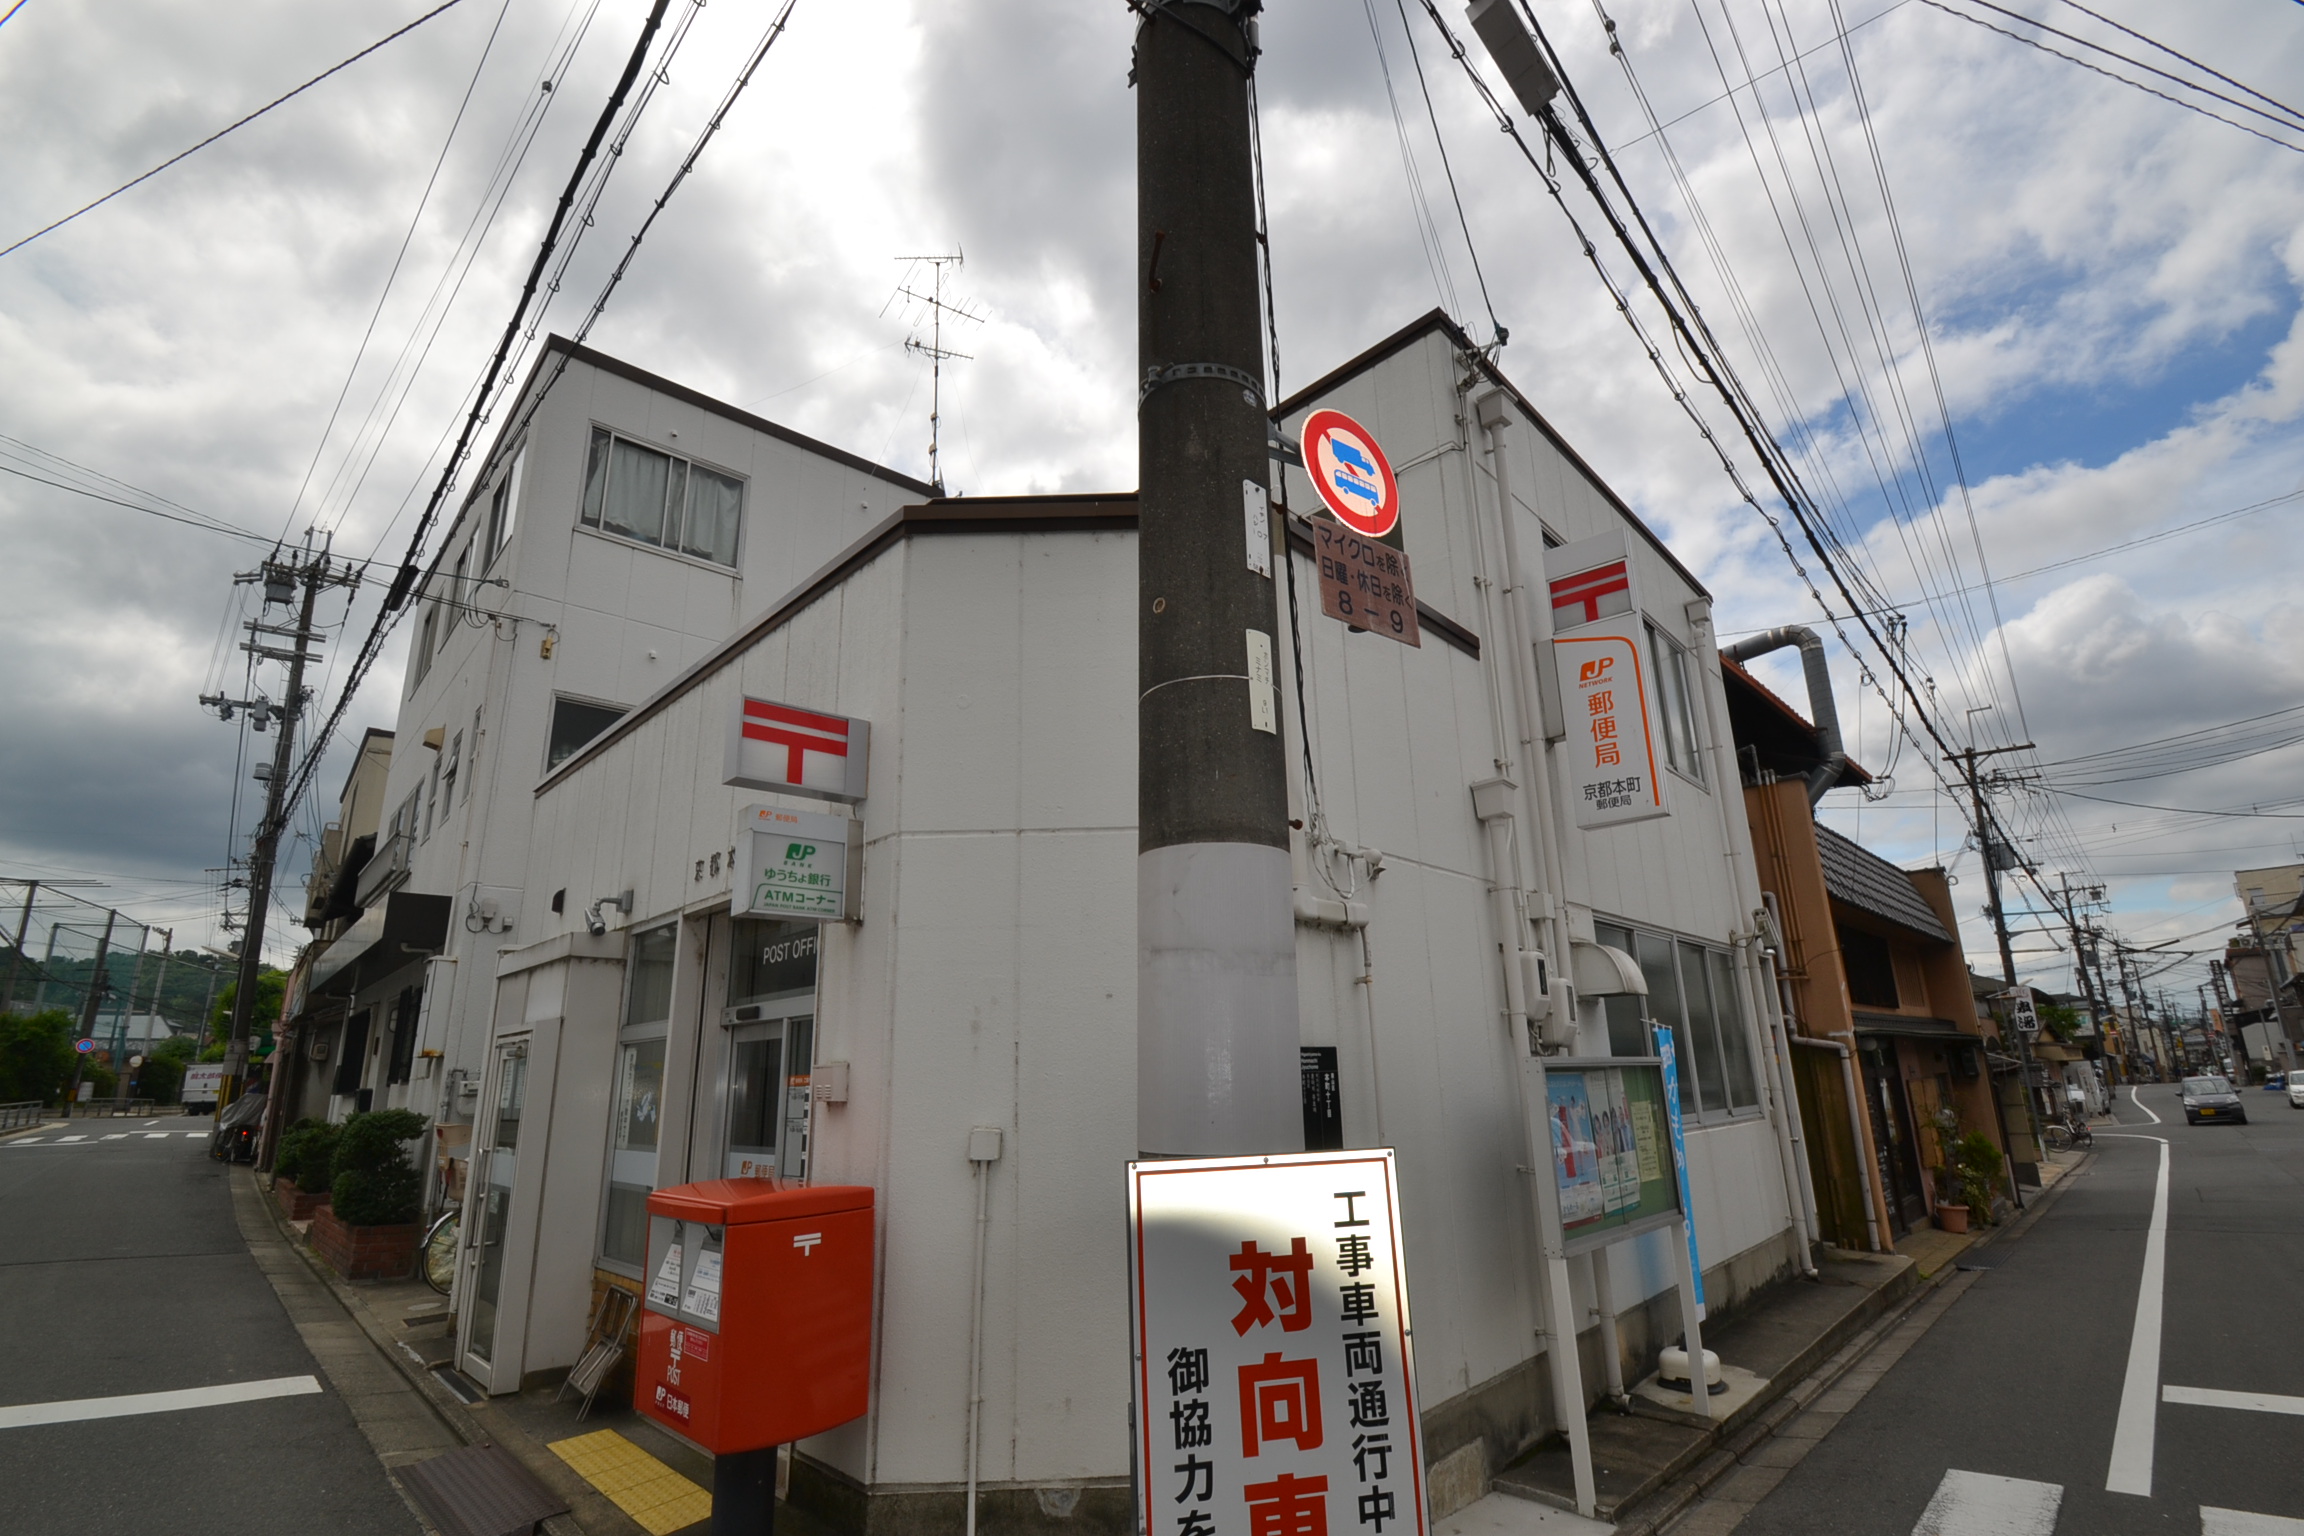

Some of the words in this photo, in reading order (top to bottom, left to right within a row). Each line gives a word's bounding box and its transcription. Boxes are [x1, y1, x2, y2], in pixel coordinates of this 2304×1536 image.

[1319, 526, 1408, 577] マイクロを除く
[1322, 556, 1413, 609] 日曜・休日を除く
[1579, 656, 1615, 682] JP
[1579, 677, 1614, 689] NETWORK
[1587, 690, 1621, 769] 郵便局
[1583, 776, 1641, 801] 京都本町
[1596, 795, 1632, 811] 郵便局
[783, 860, 813, 869] BANK
[785, 843, 816, 861] JP
[764, 868, 831, 887] ゆうちょ銀行
[764, 889, 836, 905] ATMコーナー
[763, 942, 789, 965] POST
[792, 936, 819, 959] OFFI
[669, 1328, 684, 1353] 郵便
[1334, 1191, 1396, 1534] 工事車両通行中
[666, 1365, 682, 1387] POST
[666, 1393, 690, 1420] 日本郵便
